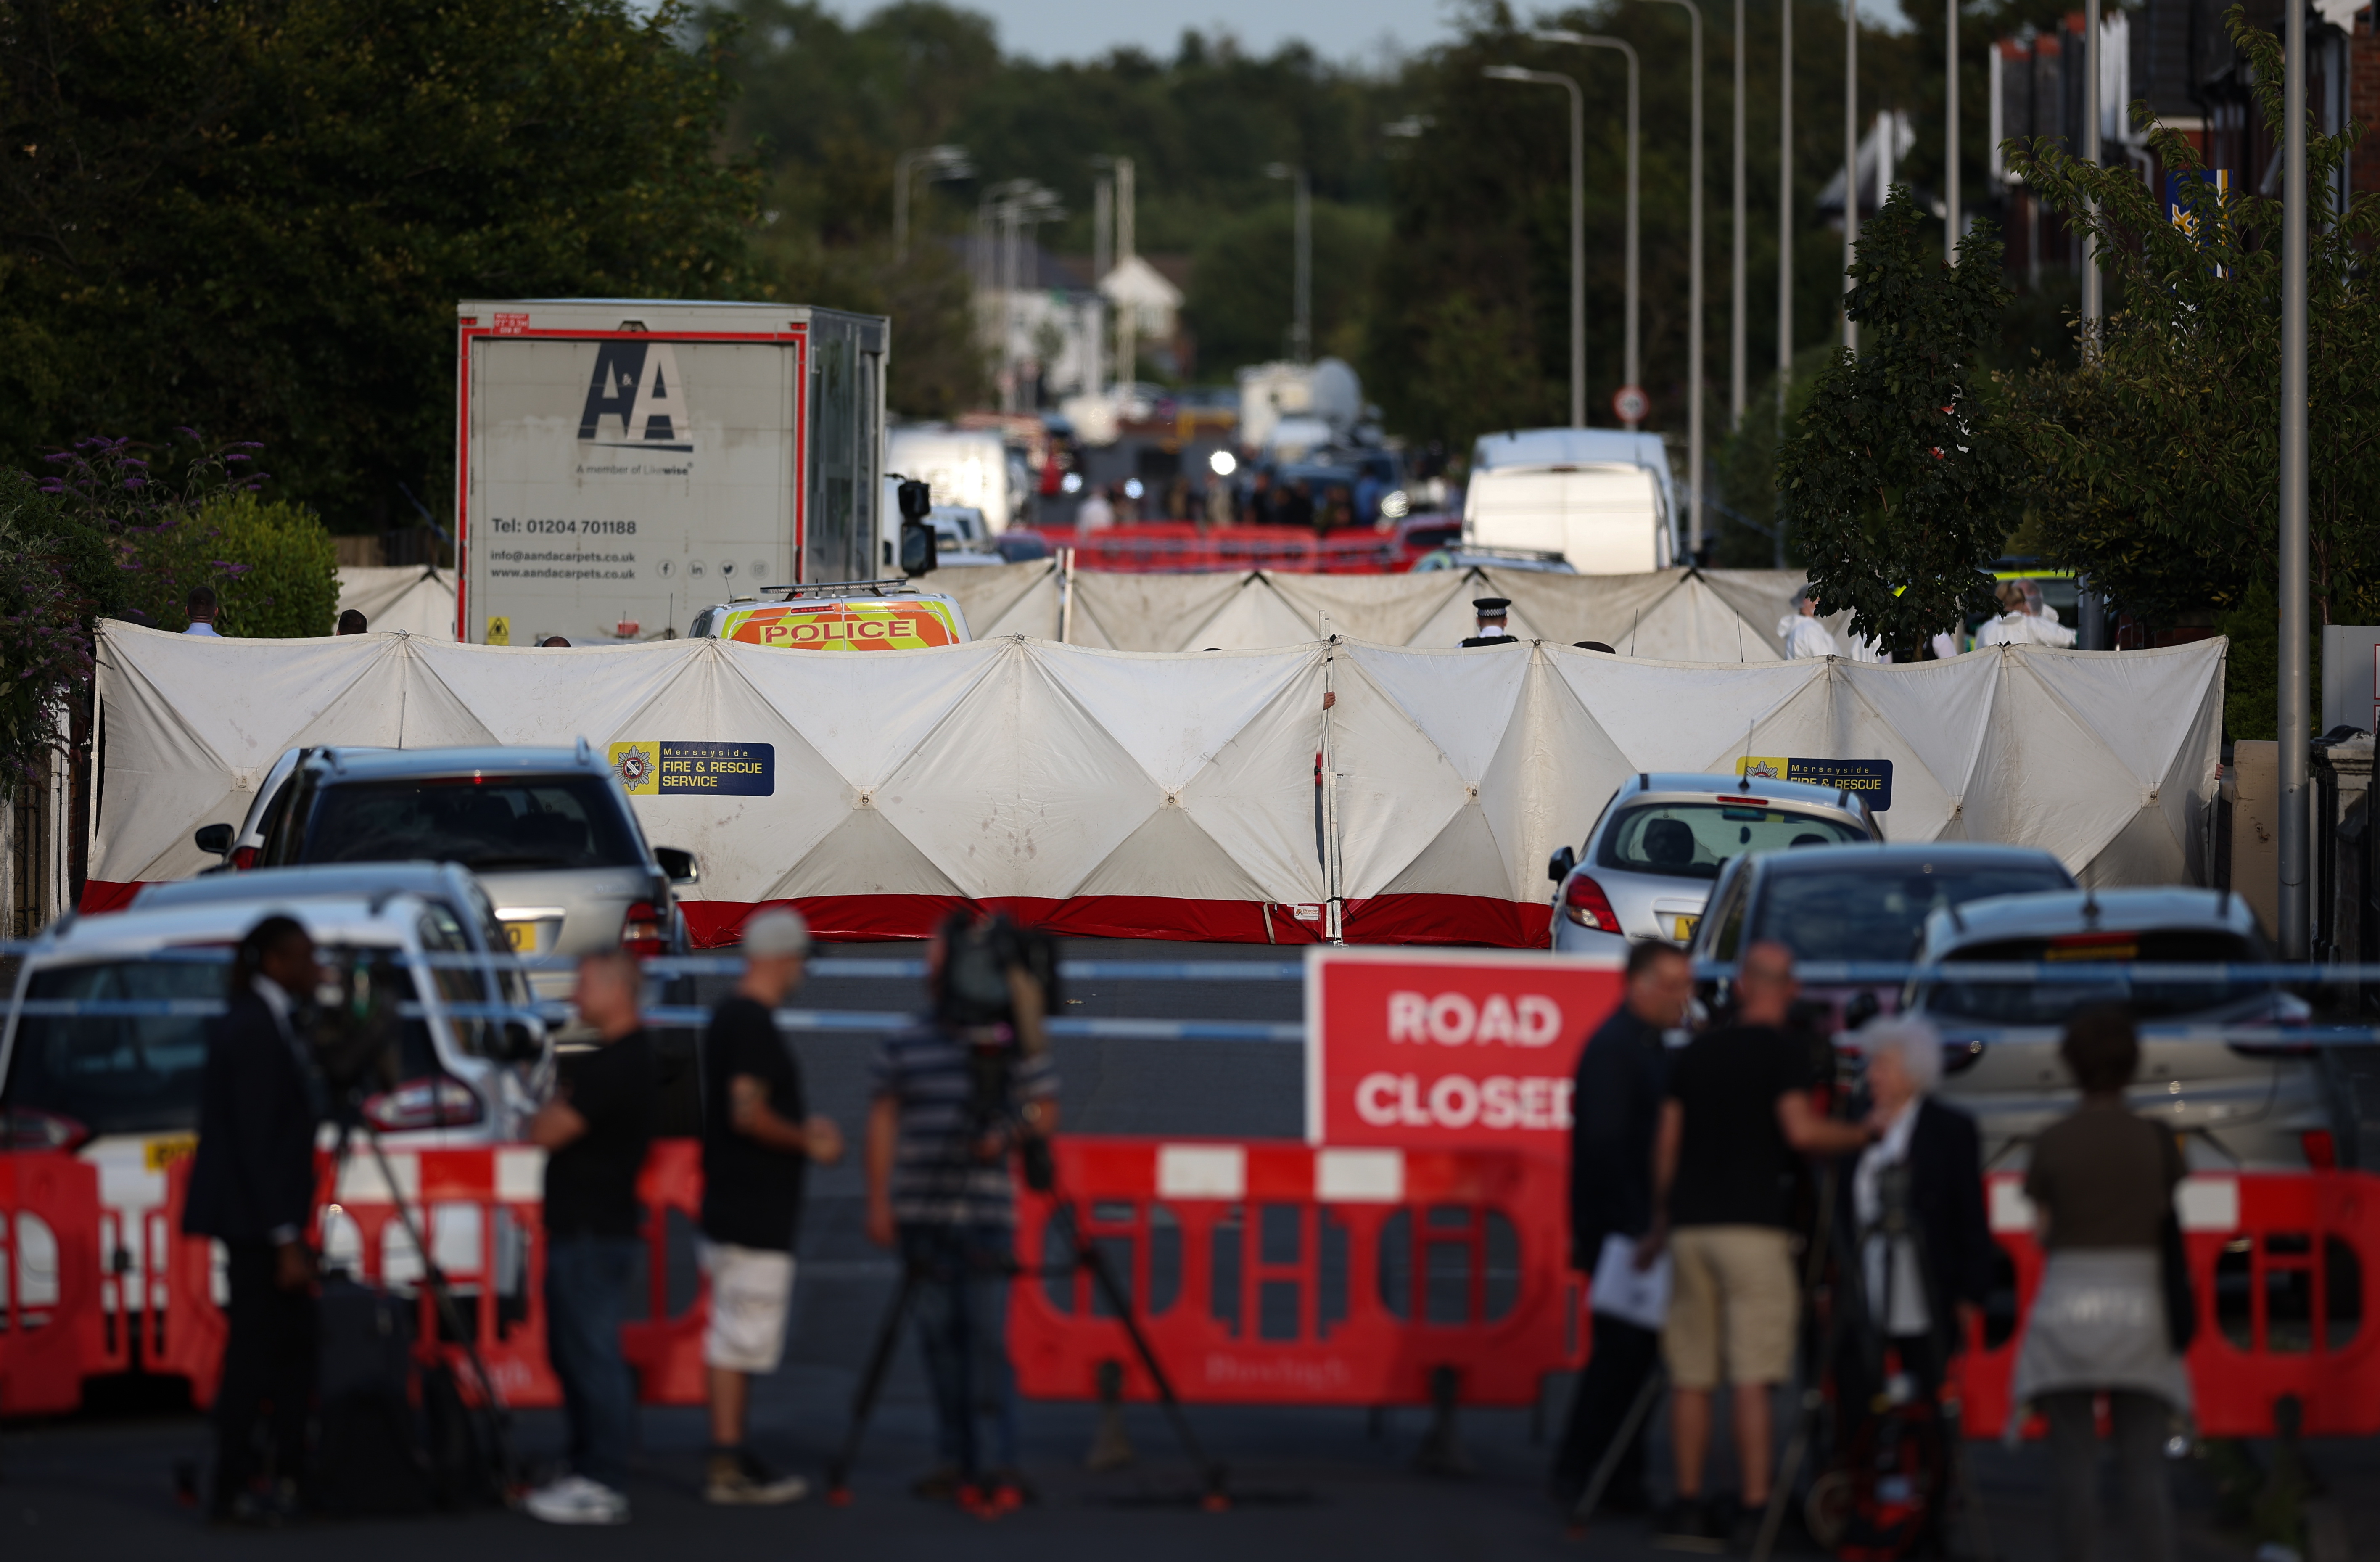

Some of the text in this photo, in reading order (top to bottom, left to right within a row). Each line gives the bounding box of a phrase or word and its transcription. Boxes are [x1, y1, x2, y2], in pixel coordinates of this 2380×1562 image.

[586, 465, 627, 474] member
[632, 465, 641, 474] of
[492, 518, 636, 534] Tel: 01204 701188
[491, 550, 635, 564] info@aandacarpets.co.uk
[491, 568, 635, 580] www.aandacarpets.co.uk
[765, 621, 911, 643] POLICE
[663, 748, 748, 757] Merseyside
[663, 761, 762, 774] FIRE & RESCUE
[1791, 764, 1869, 774] Merseyside
[663, 776, 718, 787] SERVICE
[1835, 779, 1881, 790] RESCUE
[1387, 990, 1562, 1047] ROAD
